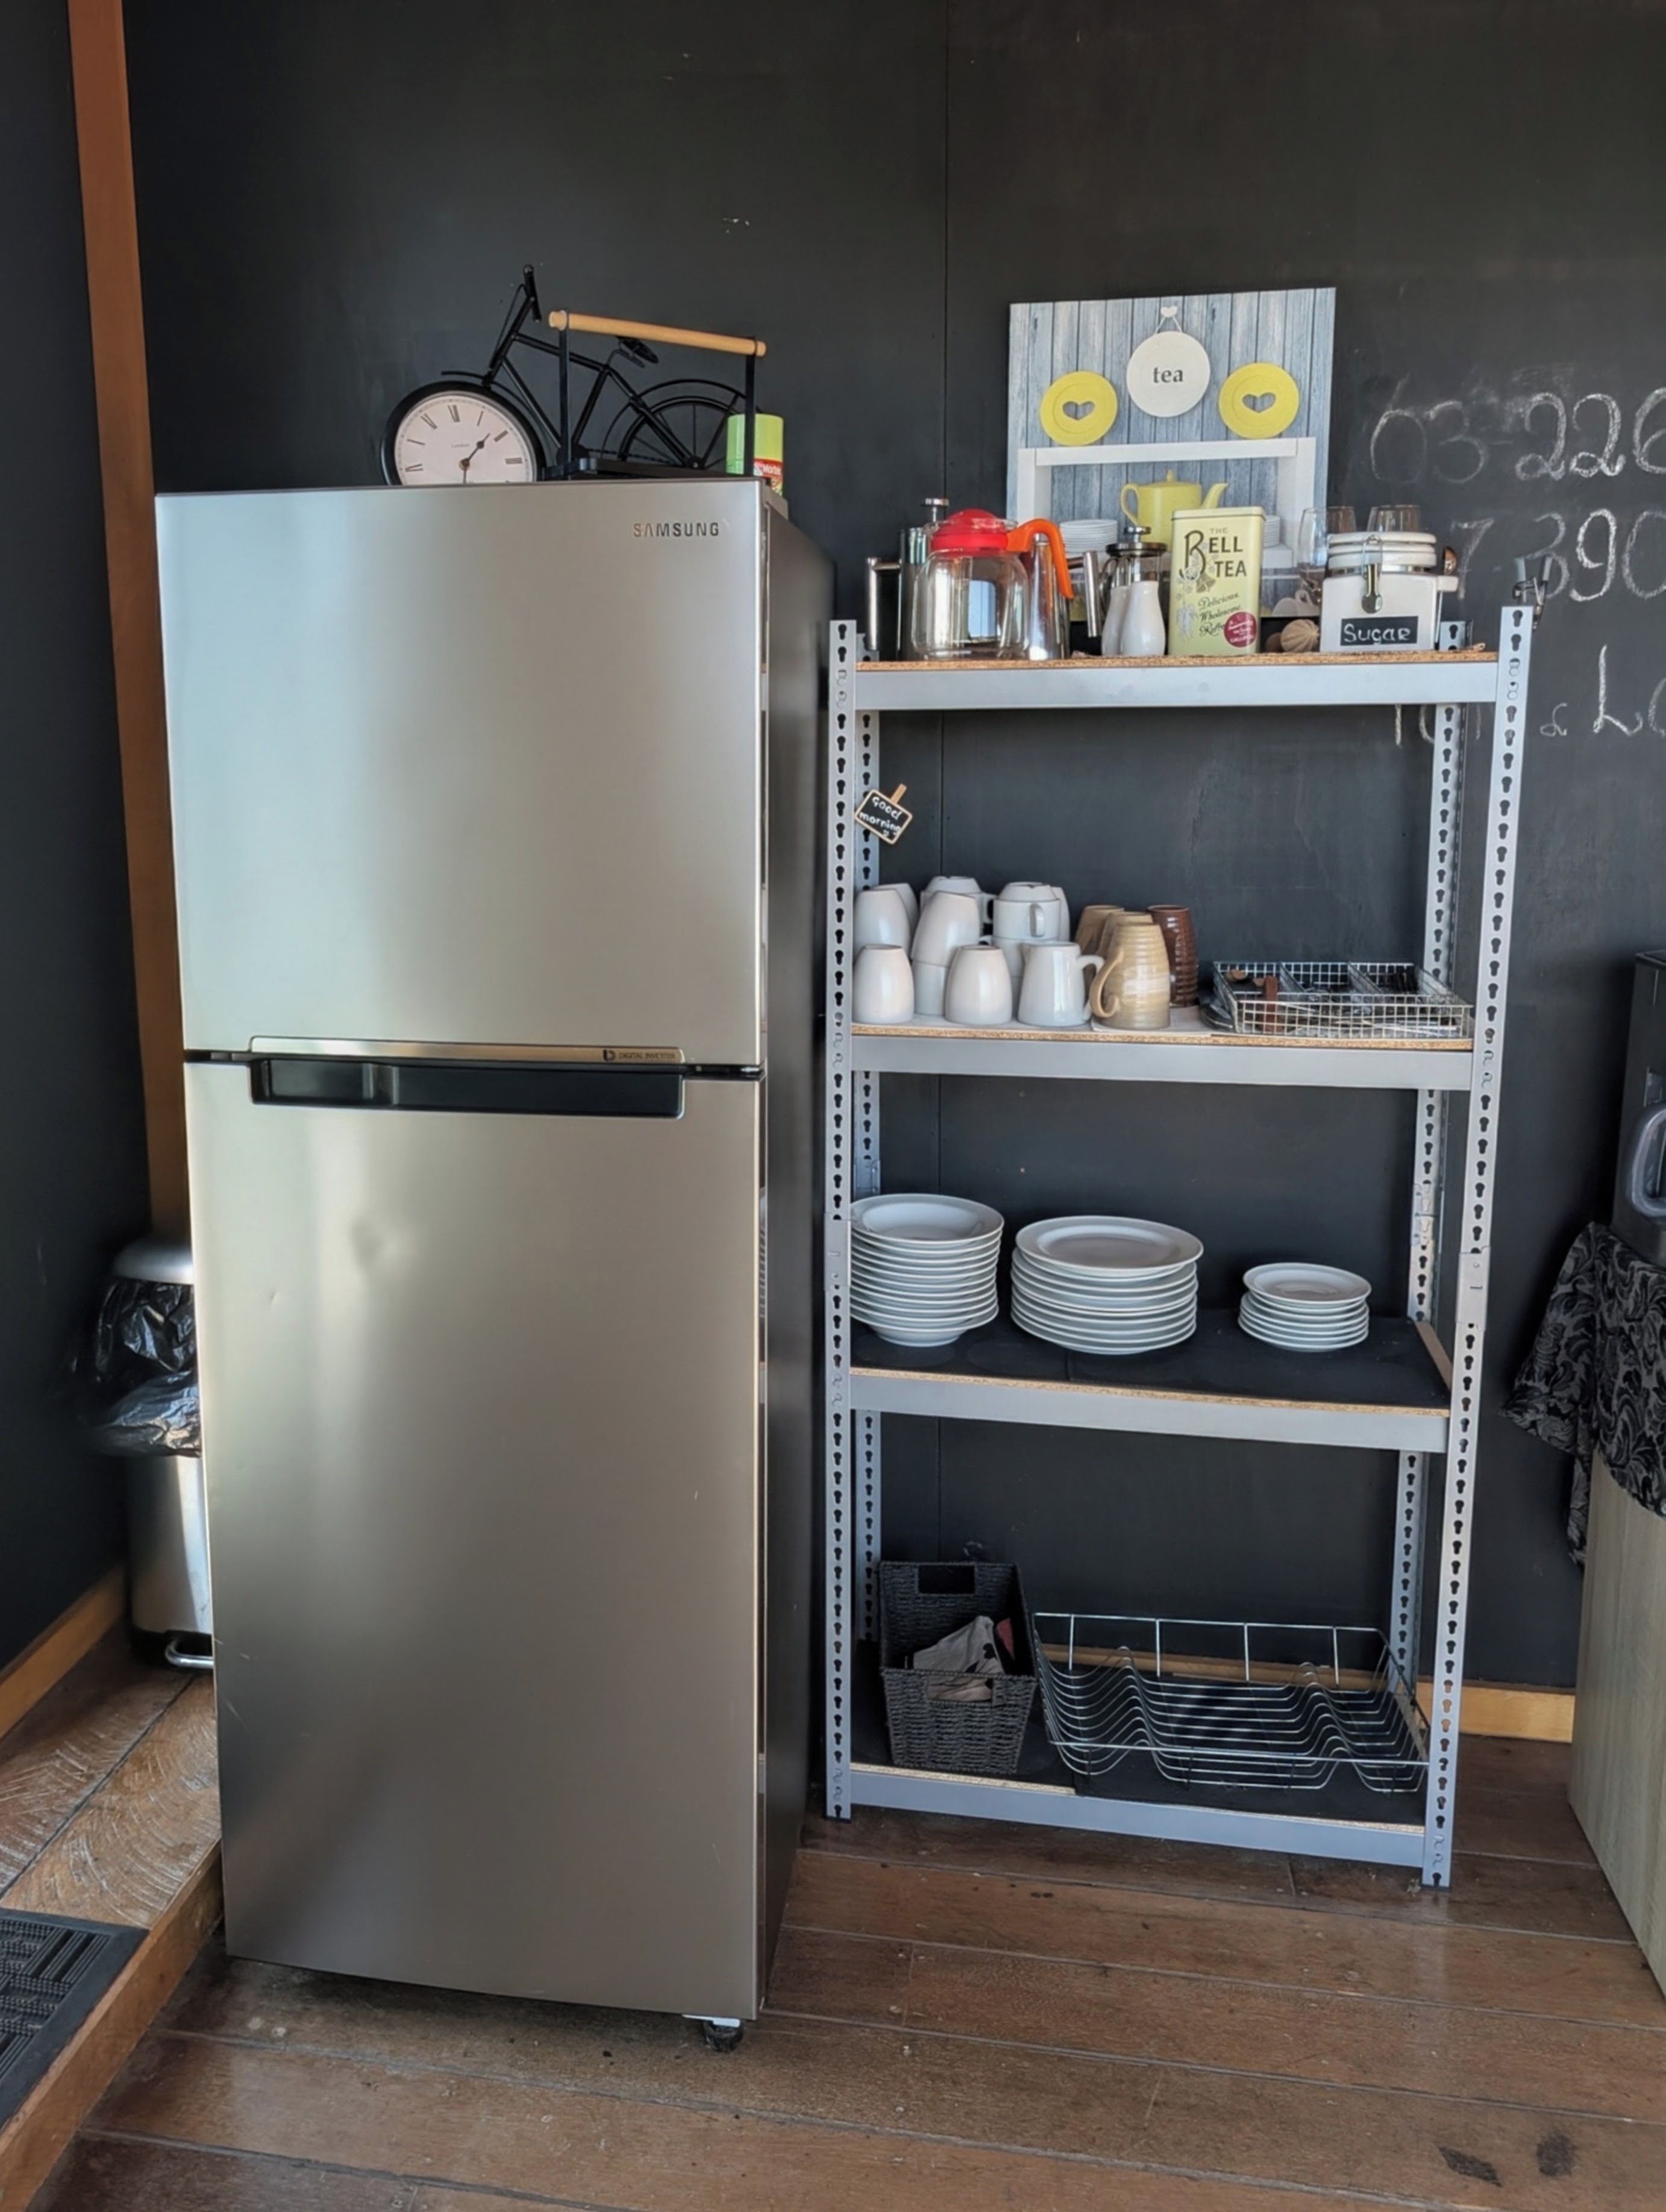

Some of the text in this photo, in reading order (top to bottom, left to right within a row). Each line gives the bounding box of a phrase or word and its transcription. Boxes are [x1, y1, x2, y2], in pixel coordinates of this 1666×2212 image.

[1152, 366, 1184, 383] tea
[633, 522, 719, 537] SAMSUNG
[1179, 530, 1244, 579] BELL
[1214, 560, 1247, 578] TEA
[1344, 623, 1411, 645] Sugar
